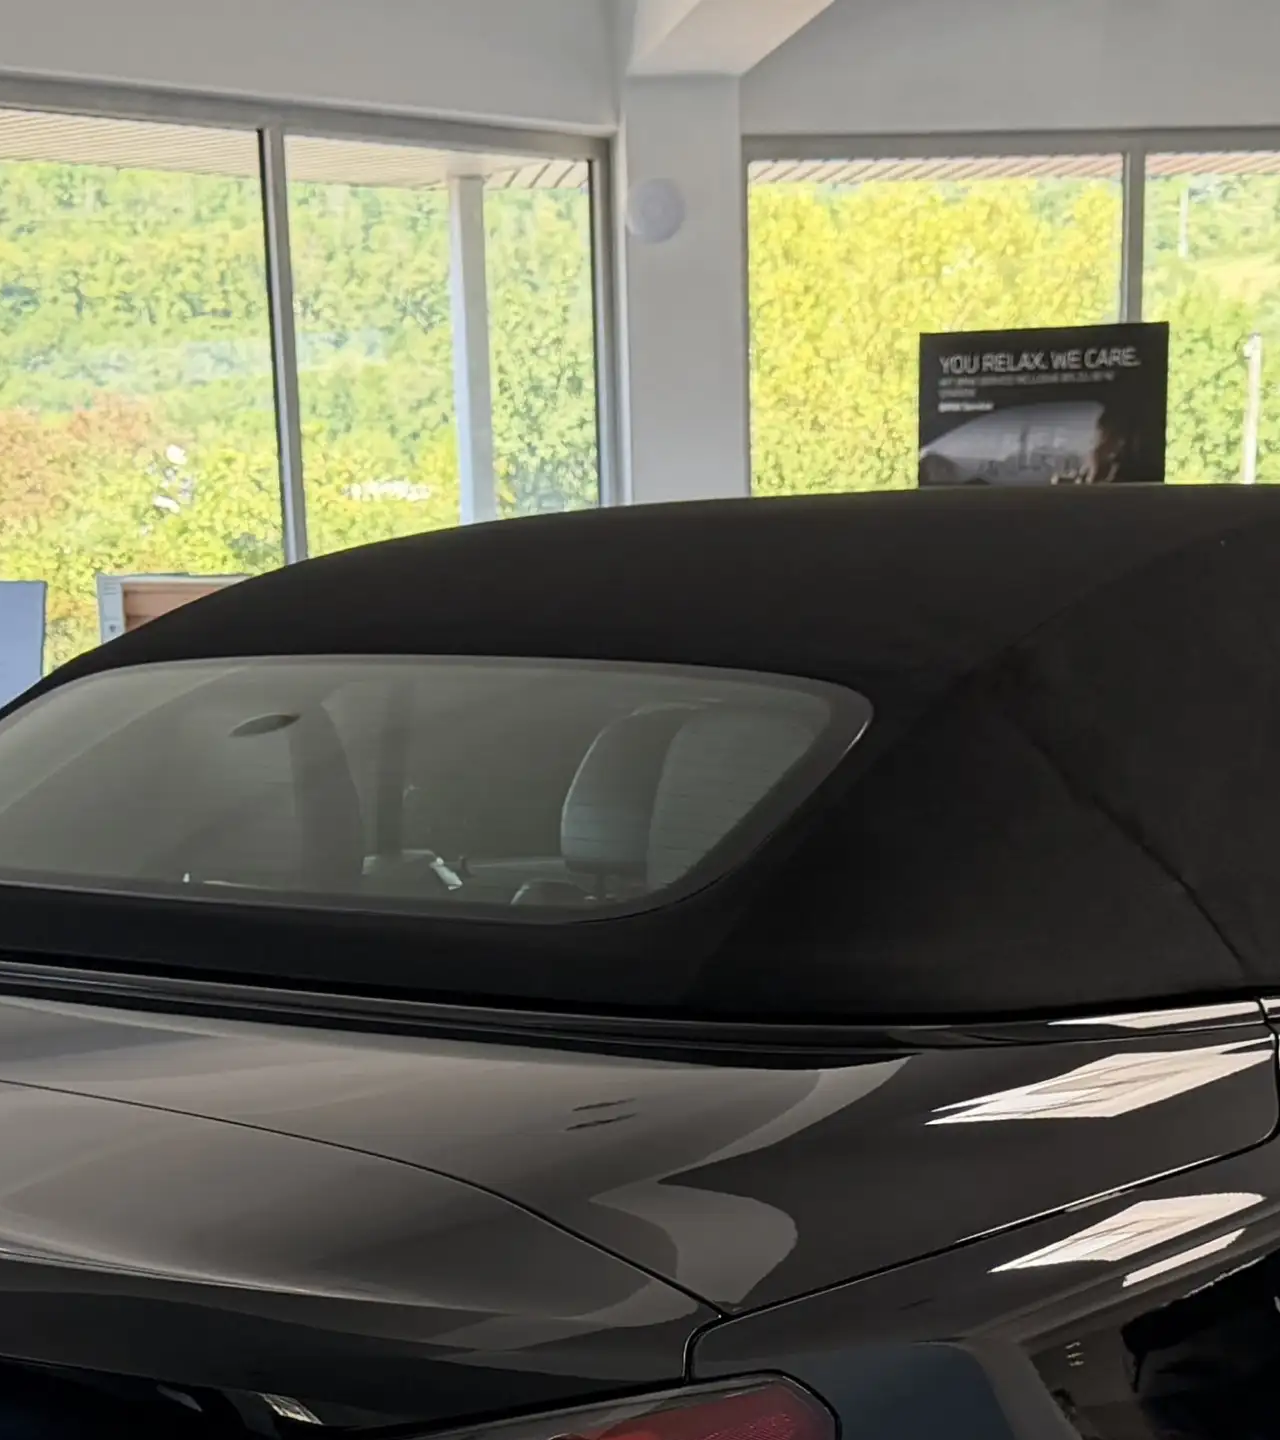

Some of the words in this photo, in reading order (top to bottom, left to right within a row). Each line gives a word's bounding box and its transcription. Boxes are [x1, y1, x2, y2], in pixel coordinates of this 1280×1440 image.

[939, 354, 980, 375] YOU
[982, 351, 1048, 373] RELAX.
[1051, 349, 1081, 371] WE
[1084, 347, 1141, 368] CARE.
